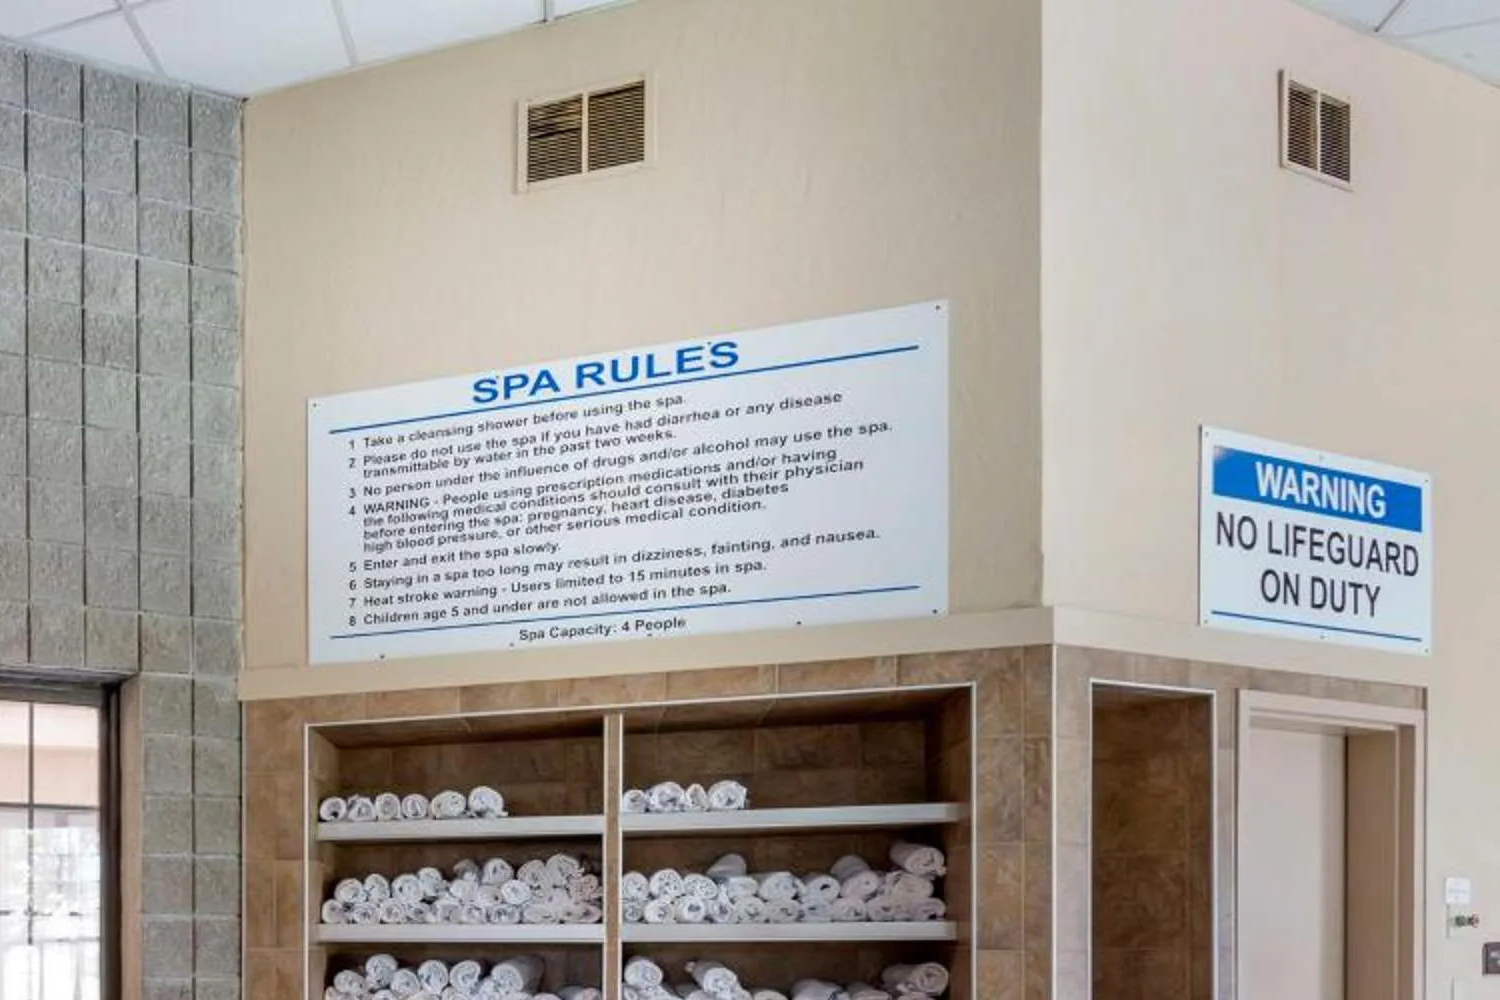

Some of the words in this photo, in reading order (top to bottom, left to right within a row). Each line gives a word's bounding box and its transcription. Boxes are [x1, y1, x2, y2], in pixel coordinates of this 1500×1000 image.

[471, 368, 561, 405] SPA
[575, 341, 740, 390] RULES
[348, 439, 355, 450] 1
[363, 435, 393, 448] Take
[396, 434, 405, 444] a
[407, 424, 474, 442] cleansing
[477, 417, 528, 433] shower
[532, 409, 578, 425] before
[582, 403, 623, 418] using
[627, 398, 651, 411] the
[348, 457, 356, 469] 2
[362, 452, 407, 467] Please
[409, 449, 428, 461] do
[430, 444, 453, 458] not
[456, 442, 482, 454] use
[485, 437, 507, 450] the
[510, 435, 537, 448] spa
[540, 430, 550, 443] if
[553, 429, 581, 444] you
[584, 423, 621, 437] have
[624, 416, 653, 432] had
[655, 409, 720, 427] diarrhea
[724, 407, 740, 418] or
[745, 402, 775, 415] any
[778, 393, 843, 411] disease
[348, 488, 356, 499] 3
[363, 485, 382, 497] No
[384, 480, 431, 497] person
[435, 474, 474, 488] under
[477, 470, 500, 483] the
[504, 462, 569, 480] influence
[573, 458, 589, 471] of
[591, 454, 635, 468] drugs
[639, 447, 688, 463] and/or
[692, 437, 750, 456] alcohol
[754, 434, 788, 448] may
[792, 430, 822, 443] use
[827, 425, 853, 439] the
[348, 505, 356, 517] 4
[363, 496, 430, 515] WARNING
[442, 490, 489, 506] People
[492, 486, 532, 499] using
[535, 474, 624, 497] prescription
[628, 463, 721, 483] medications
[725, 455, 777, 471] and/or
[780, 448, 837, 464] having
[362, 458, 450, 479] transmittable
[453, 455, 471, 469] by
[473, 451, 512, 465] water
[515, 448, 529, 459] in
[532, 444, 556, 457] the
[559, 438, 591, 456] past
[594, 436, 621, 449] two
[362, 516, 385, 528] the
[386, 509, 449, 525] following
[451, 500, 507, 518] medical
[508, 493, 585, 511] conditions
[589, 484, 641, 502] should
[643, 477, 702, 495] consult
[704, 472, 739, 488] with
[742, 468, 780, 484] their
[783, 460, 864, 481] physician
[363, 527, 406, 541] before
[408, 520, 465, 535] entering
[467, 516, 491, 529] the
[610, 497, 650, 512] heart
[720, 483, 789, 500] diabetes
[1254, 461, 1387, 518] WARNING
[363, 539, 393, 554] high
[395, 534, 435, 550] blood
[505, 527, 521, 537] or
[524, 522, 562, 535] other
[566, 516, 621, 531] serious
[624, 506, 683, 524] medical
[1216, 511, 1258, 550] NO
[1267, 520, 1419, 577] LIFEGUARD
[348, 561, 357, 573] 5
[362, 558, 399, 571] Enter
[401, 554, 427, 567] and
[430, 551, 455, 564] exit
[458, 549, 481, 561] the
[484, 547, 509, 560] spa
[348, 579, 357, 591] 6
[362, 575, 413, 589] Staying
[415, 573, 429, 584] in
[432, 573, 441, 583] a
[443, 570, 469, 583] spa
[471, 567, 495, 579] too
[498, 564, 530, 576] long
[532, 560, 564, 573] may
[567, 553, 609, 569] result
[613, 553, 627, 564] in
[779, 533, 811, 548] and
[348, 597, 357, 609] 7
[363, 593, 394, 607] Heat
[396, 590, 439, 604] stroke
[441, 585, 498, 600] warning
[510, 580, 552, 593] Users
[554, 573, 605, 589] limited
[608, 572, 624, 584] to
[627, 569, 646, 582] 15
[648, 564, 711, 580] minutes
[714, 562, 730, 574] in
[347, 615, 357, 627] 8
[362, 612, 419, 625] Children
[422, 609, 447, 622] age
[450, 606, 459, 618] 5
[462, 603, 489, 617] and
[492, 600, 533, 614] under
[536, 599, 559, 610] are
[562, 594, 587, 608] not
[590, 588, 649, 605] allowed
[652, 588, 667, 599] in
[670, 585, 695, 598] the
[1260, 568, 1300, 606] ON
[1310, 576, 1381, 617] DUTY
[518, 629, 545, 642] Spa
[620, 620, 631, 632] 4
[634, 616, 686, 631] People
